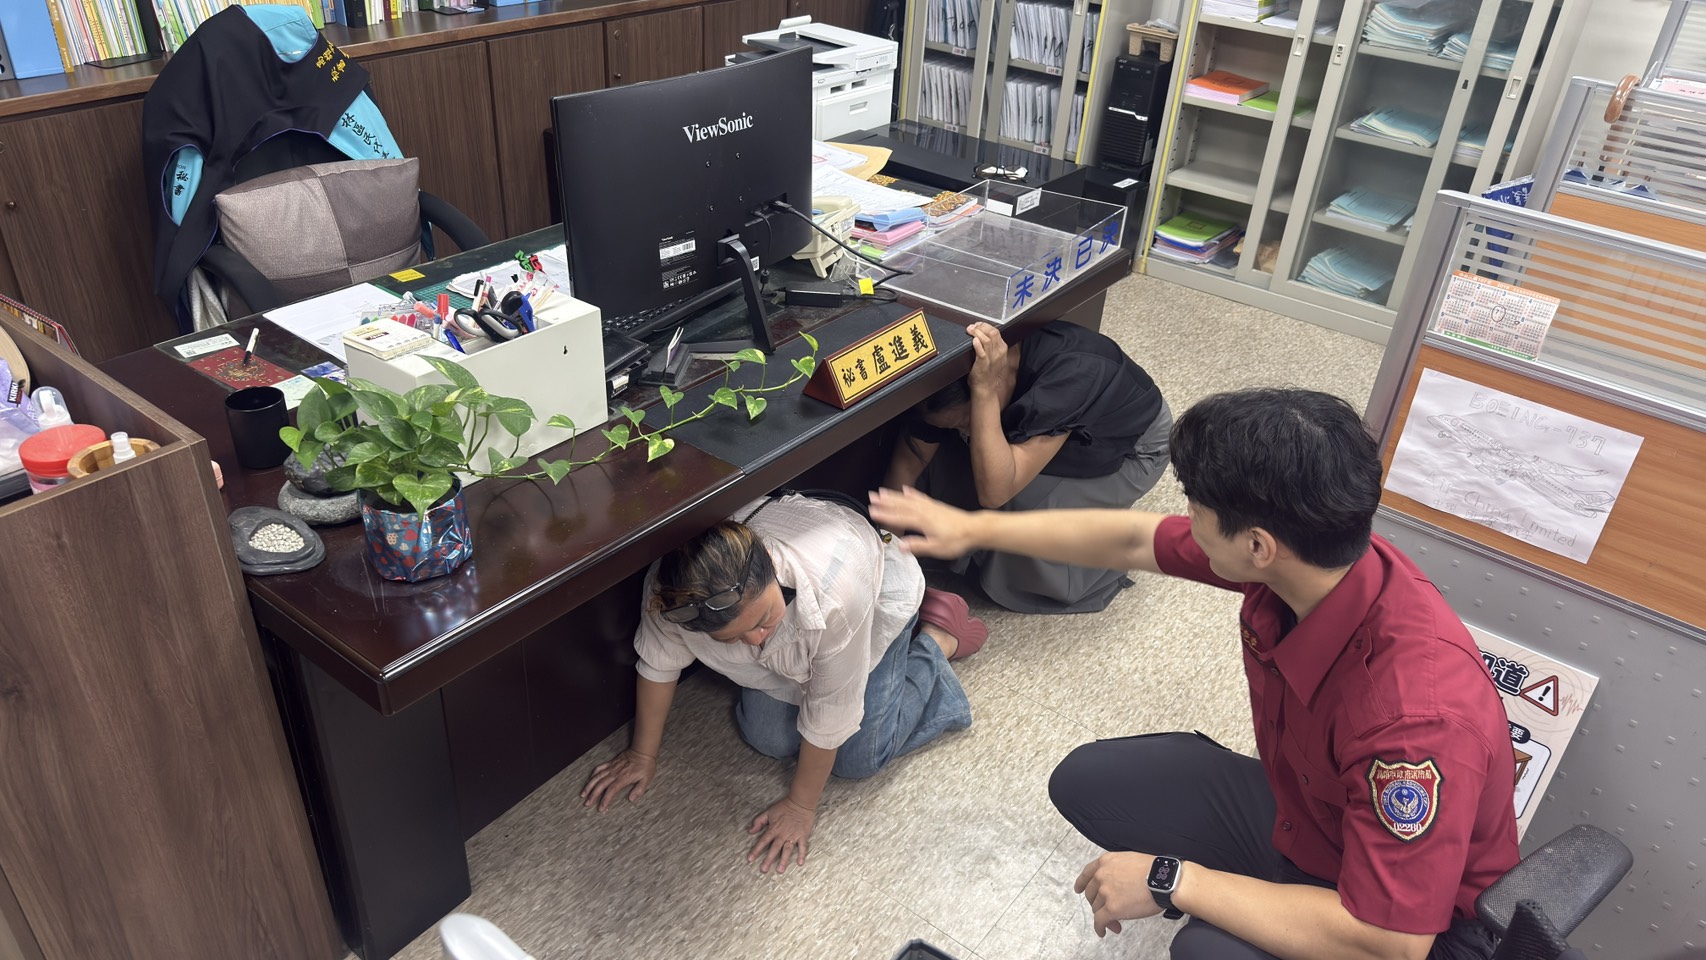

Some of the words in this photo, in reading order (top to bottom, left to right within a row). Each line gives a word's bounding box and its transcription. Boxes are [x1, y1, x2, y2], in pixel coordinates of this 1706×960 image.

[682, 112, 753, 143] ViewSonic
[1012, 256, 1062, 309] 未決
[1075, 221, 1118, 269] 已決
[872, 324, 928, 375] 盧進義
[1464, 491, 1512, 523] China
[1522, 512, 1577, 547] Limited
[1508, 723, 1525, 740] 要
